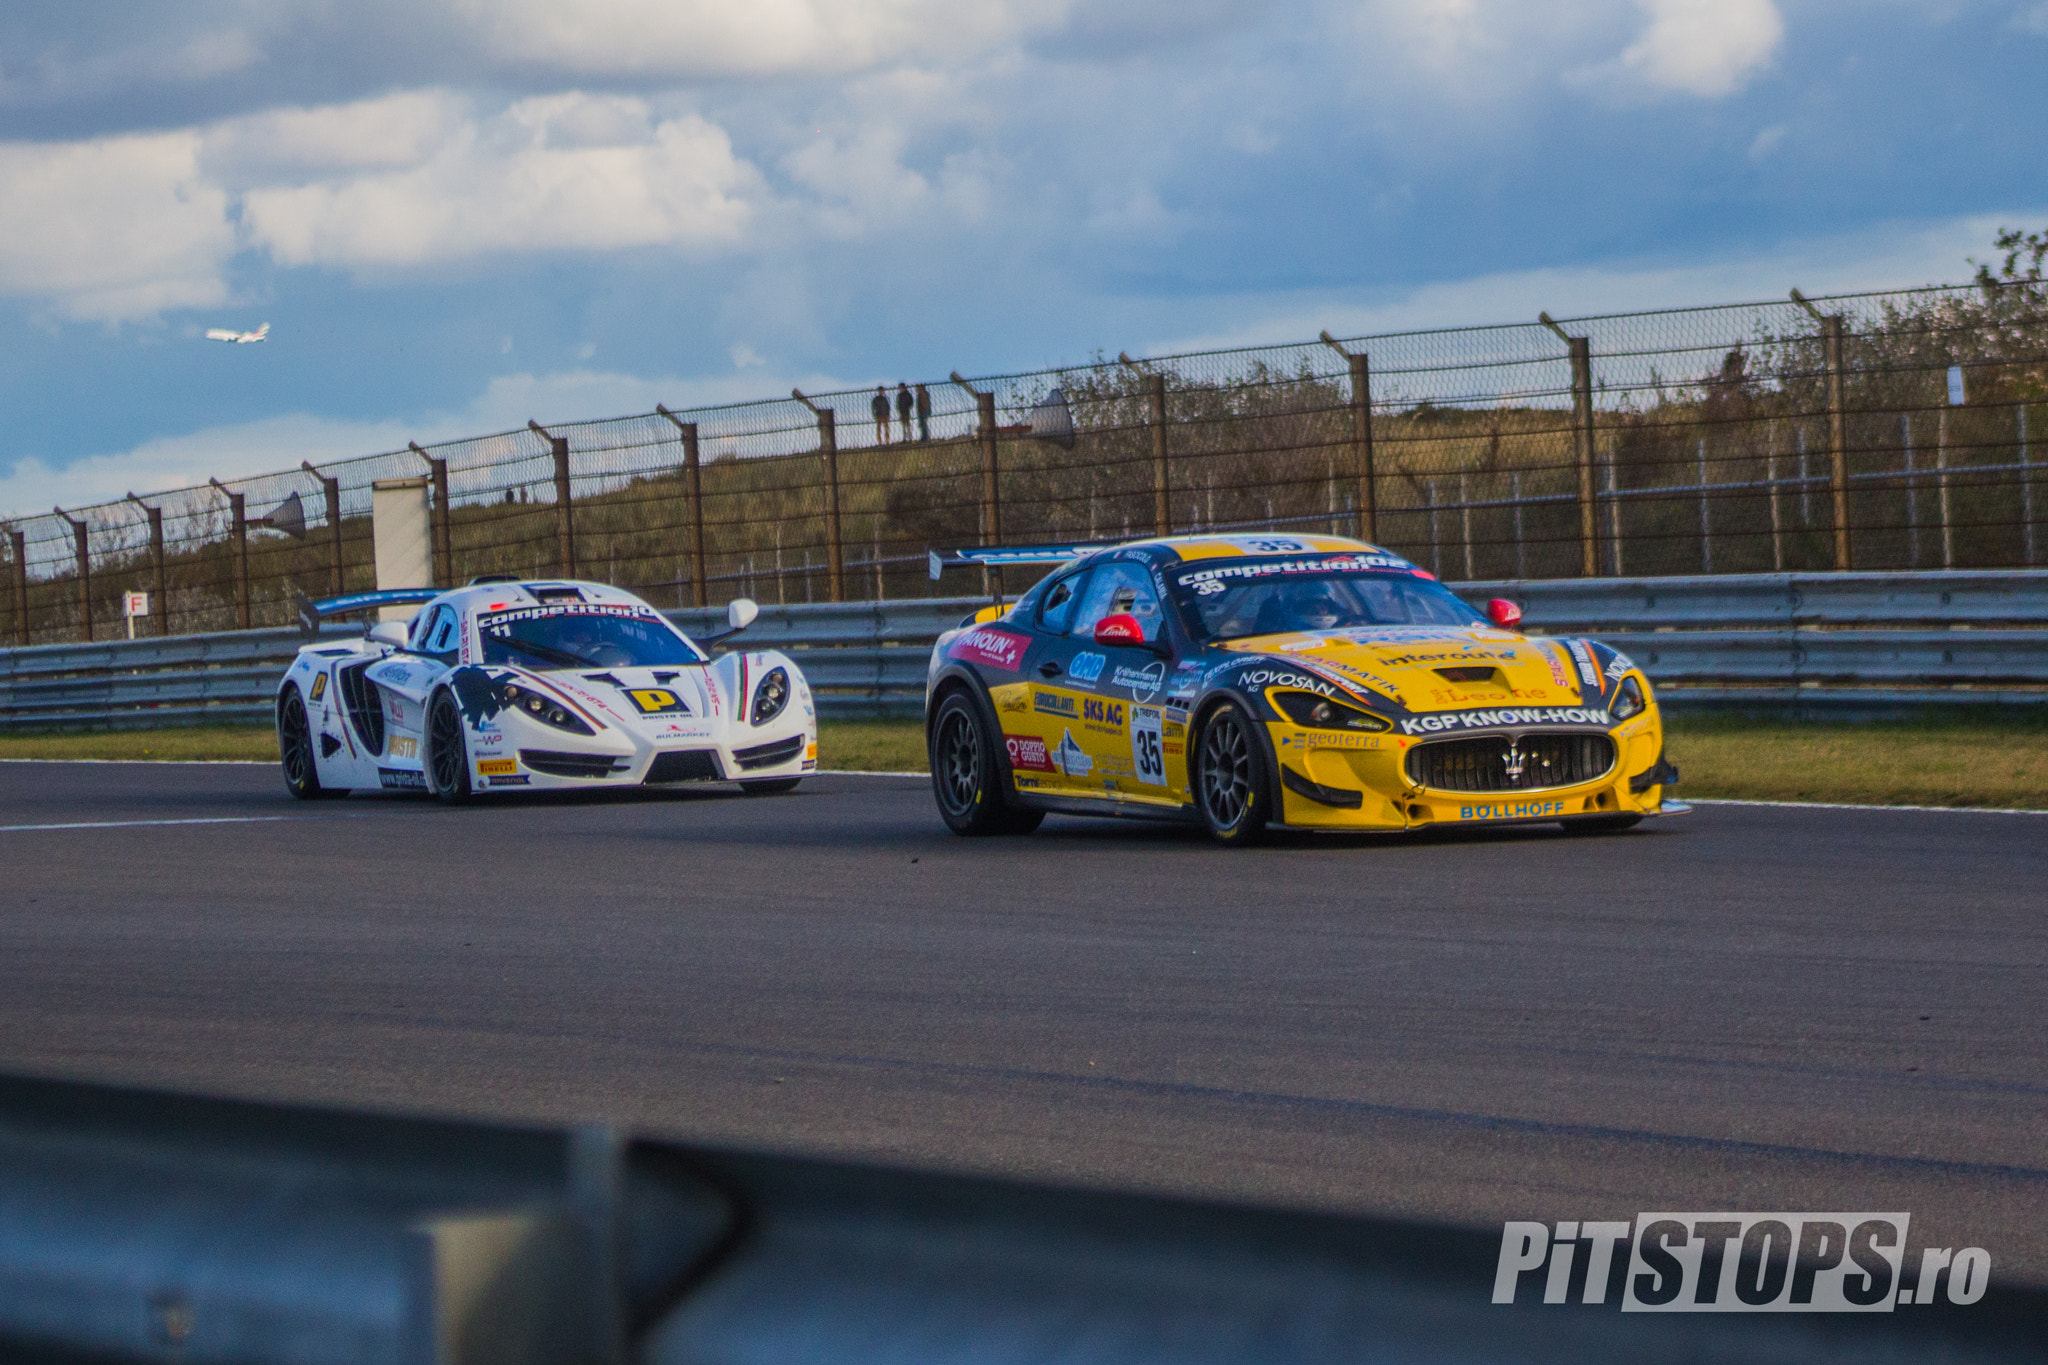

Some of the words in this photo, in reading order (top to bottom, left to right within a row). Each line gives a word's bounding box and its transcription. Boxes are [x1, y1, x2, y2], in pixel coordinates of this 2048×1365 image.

[1249, 540, 1303, 552] 35
[1192, 579, 1227, 596] 35
[131, 596, 143, 612] F
[490, 624, 512, 637] 11
[1097, 625, 1131, 637] Linde
[1377, 650, 1517, 666] interoute
[1237, 671, 1337, 696] NOVOSAN
[630, 690, 676, 712] P
[1083, 698, 1104, 722] SKS
[1105, 702, 1122, 726] AG
[1400, 713, 1459, 735] KGP
[1459, 708, 1610, 728] KNOW-HOW
[1019, 740, 1046, 753] DOPPIO
[1308, 732, 1380, 748] geoterra
[1021, 751, 1046, 763] GUSTO
[1137, 730, 1162, 777] 35
